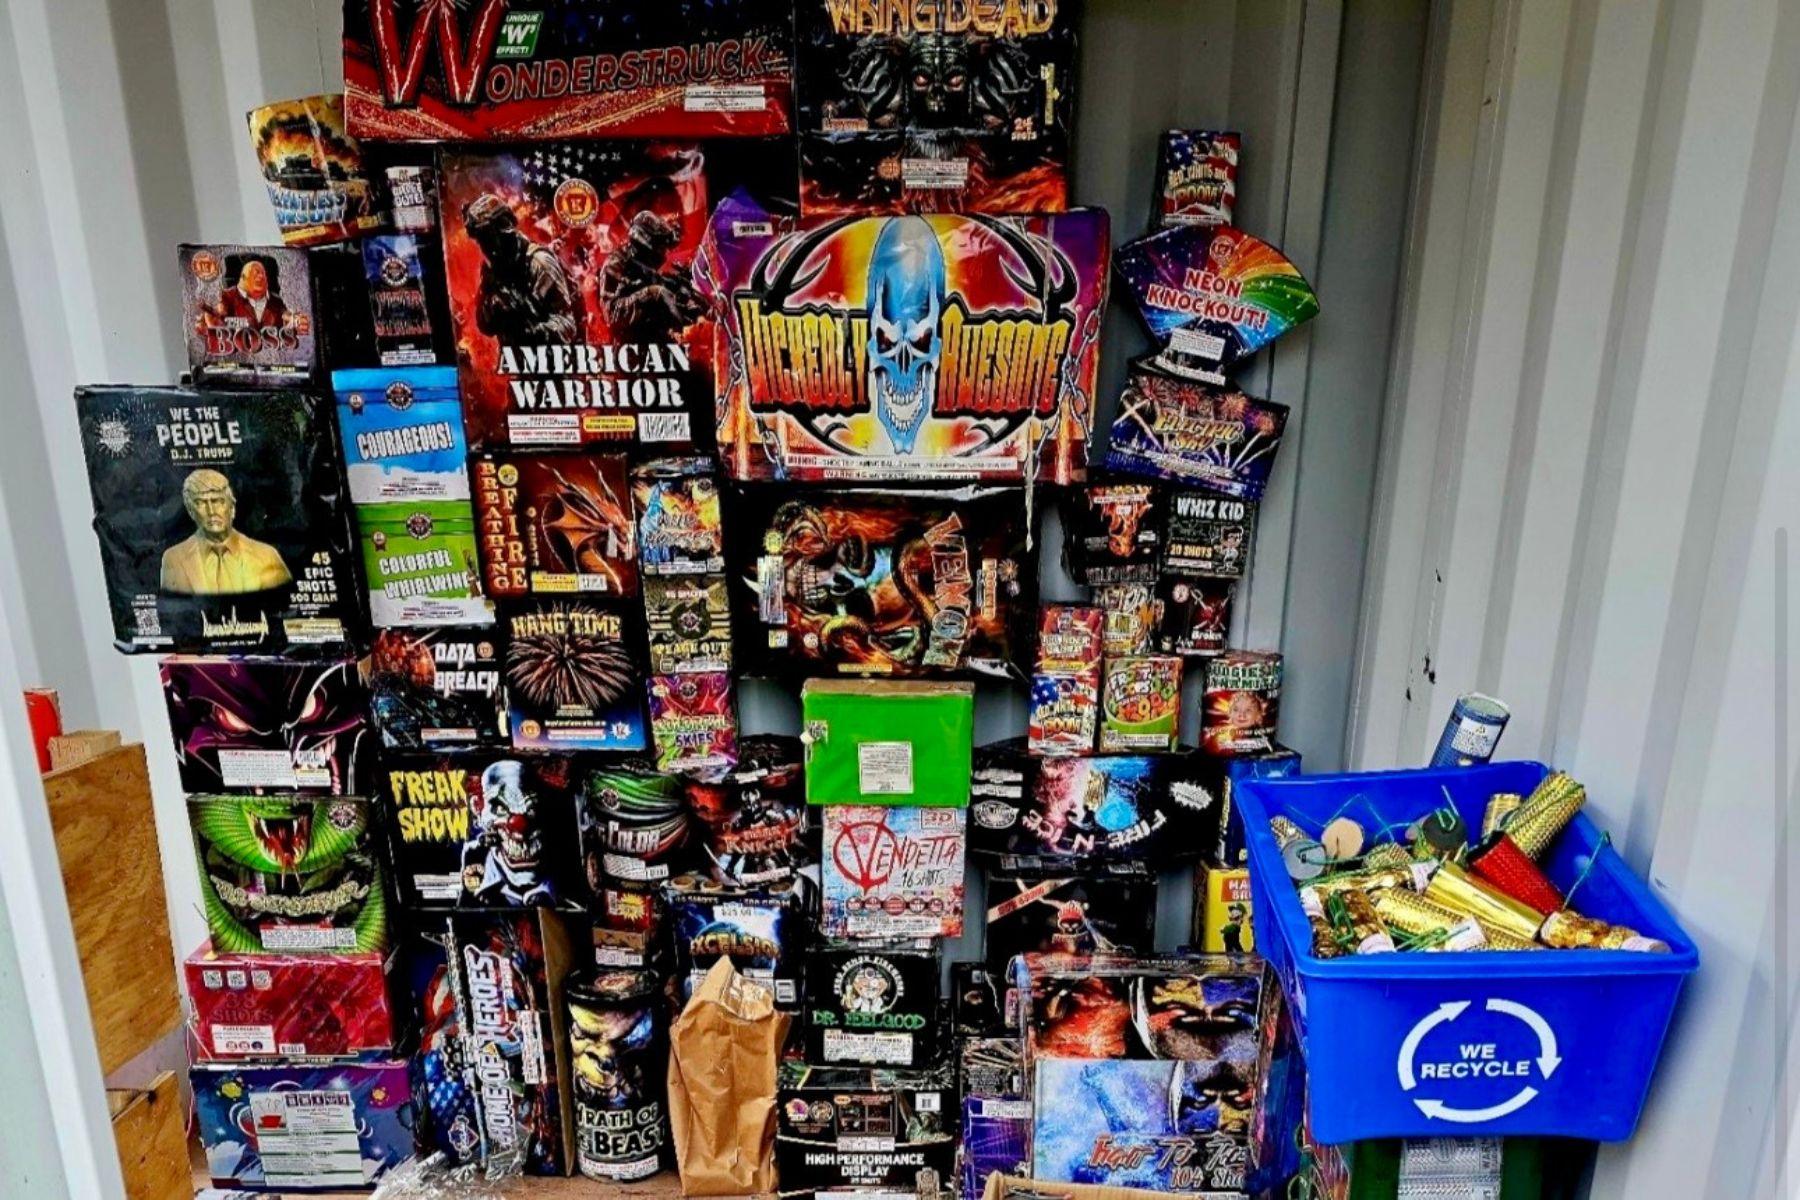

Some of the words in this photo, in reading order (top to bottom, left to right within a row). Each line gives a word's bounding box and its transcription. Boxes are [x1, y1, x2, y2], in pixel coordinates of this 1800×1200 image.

[505, 13, 539, 23] UNIQUE
[943, 0, 1058, 38] DEAD
[366, 0, 769, 106] WONDERSTRUCK
[496, 45, 530, 55] EFFECT!
[1184, 267, 1244, 299] NEON
[1146, 284, 1269, 330] KNOCKOUT!
[224, 317, 249, 328] THE
[206, 326, 300, 356] BOSS
[498, 343, 691, 374] AMERICAN
[737, 298, 868, 407] WICKEDLY
[935, 302, 1071, 414] AWESOME
[509, 377, 685, 409] WARRIOR
[169, 407, 191, 421] WE
[197, 406, 220, 420] THE
[156, 421, 242, 447] PEOPLE
[357, 422, 454, 461] COURAGEOUS!
[171, 448, 193, 459] D.J.
[197, 447, 233, 459] TRUMP
[1177, 497, 1216, 519] WHIZ
[1217, 500, 1245, 521] KID
[478, 461, 511, 590] BREATHING
[502, 487, 528, 589] FIRE
[312, 552, 332, 565] 45
[379, 549, 453, 576] COLORFUL
[1183, 544, 1213, 558] SHOTS
[297, 580, 337, 592] SHOTS
[304, 567, 334, 579] EPIC
[290, 592, 312, 602] 500
[312, 592, 338, 602] GRAM
[922, 511, 974, 670] VENOM
[511, 612, 566, 639] HANG
[568, 611, 622, 638] TIME
[434, 643, 476, 669] DATA
[653, 642, 699, 655] PEACE
[433, 671, 499, 699] BREACH
[389, 769, 468, 806] FREAK
[397, 807, 469, 844] SHOW
[607, 820, 661, 852] COLOR
[1107, 809, 1167, 850] FIRE
[837, 810, 961, 896] VENDETTA
[468, 945, 505, 1044] HEROES
[812, 1010, 839, 1025] DR.
[480, 1049, 510, 1083] OF
[1459, 1044, 1497, 1060] WE
[1420, 1060, 1531, 1080] RECYCLE
[484, 1082, 517, 1146] HOME
[805, 1153, 835, 1166] HIGH
[836, 1153, 925, 1165] PERFORMANCE
[841, 1165, 890, 1177] DISPLAY
